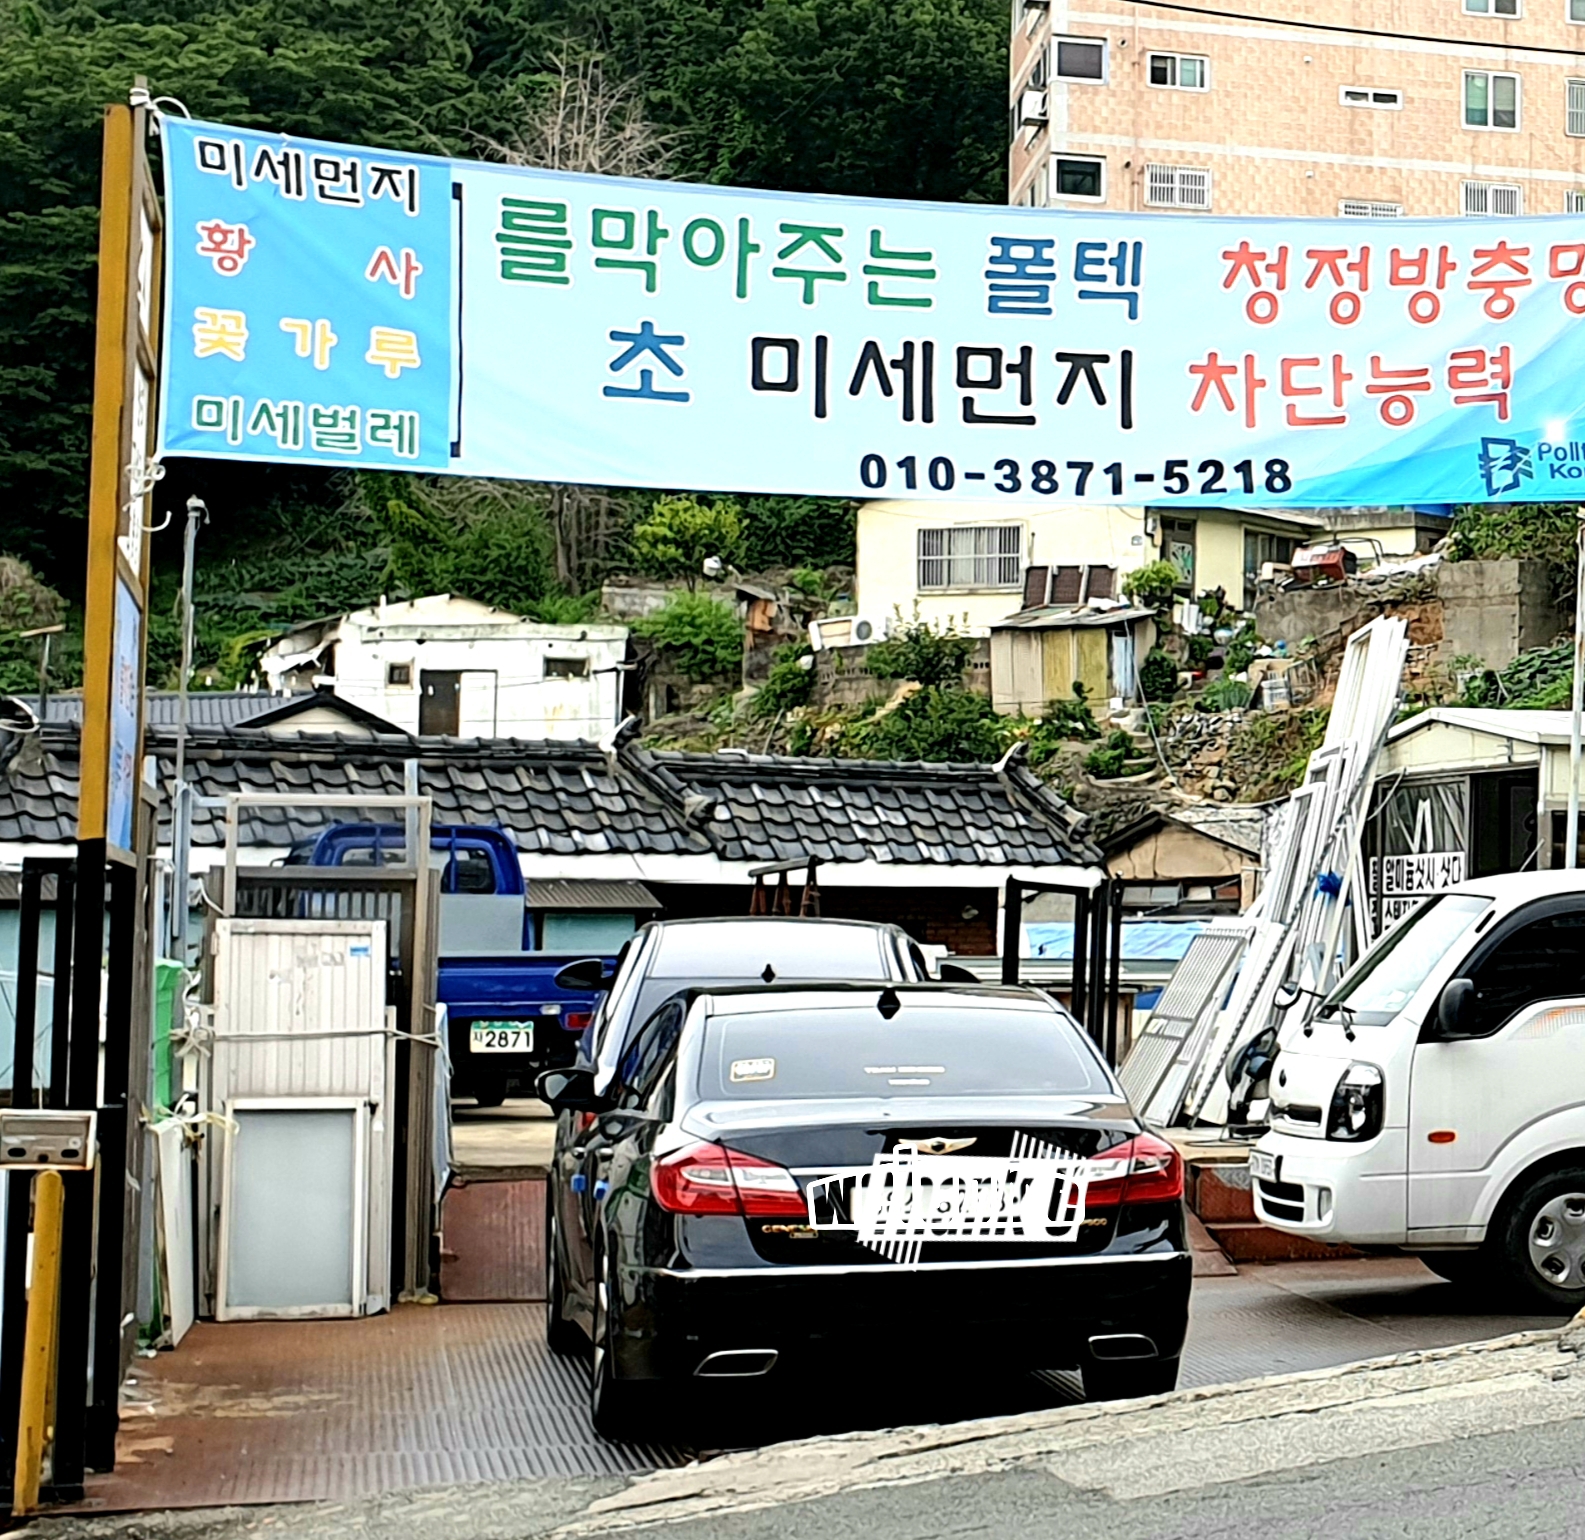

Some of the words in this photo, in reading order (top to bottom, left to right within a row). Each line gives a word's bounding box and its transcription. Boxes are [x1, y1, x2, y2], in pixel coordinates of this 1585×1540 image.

[198, 139, 418, 214] 미세먼지
[495, 196, 938, 306] 를막아주는
[984, 236, 1143, 320] 폴텍
[603, 320, 691, 403] 초
[751, 334, 1134, 430] 미세먼지
[1189, 345, 1512, 428] 차단능력
[196, 399, 416, 455] 미세벌레
[859, 453, 1293, 496] 010-3871-5218
